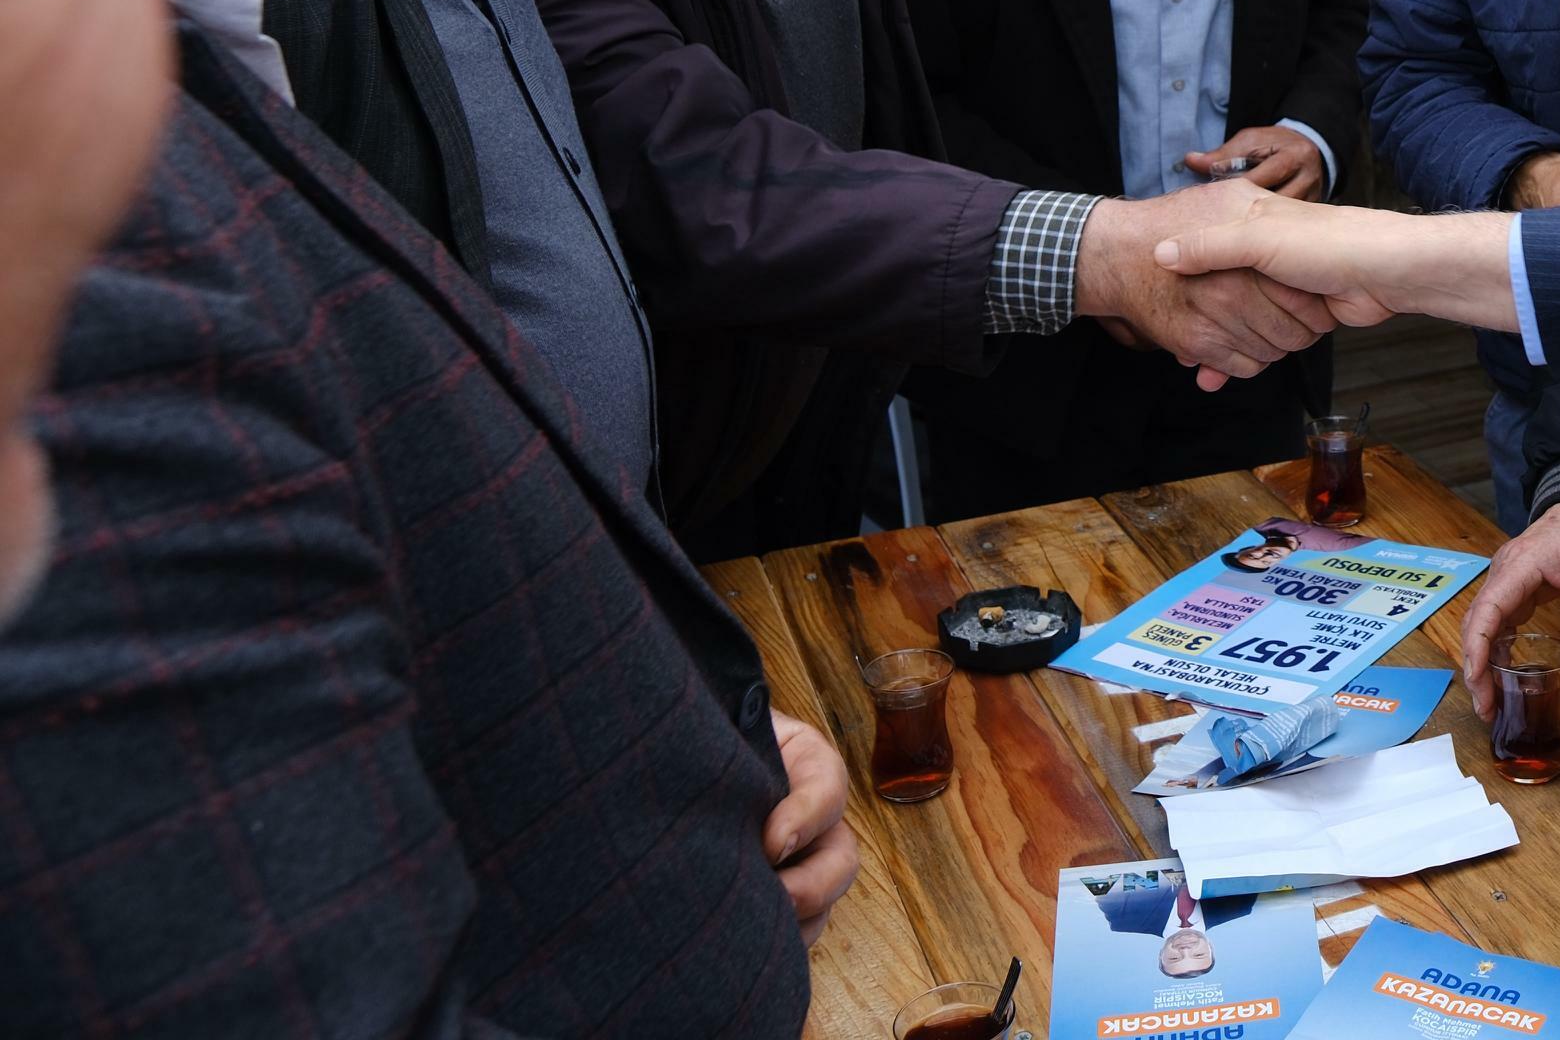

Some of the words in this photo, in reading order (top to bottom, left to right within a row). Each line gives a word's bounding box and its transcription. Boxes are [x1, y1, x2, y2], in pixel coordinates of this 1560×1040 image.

[1322, 557, 1396, 577] DEPOSU
[1261, 575, 1285, 586] KG
[1397, 571, 1427, 583] SU
[1424, 574, 1445, 588] 1
[1274, 580, 1349, 605] 300
[1204, 598, 1256, 614] MUSALLA
[1391, 595, 1421, 606] KENT
[1305, 610, 1347, 623] HATTI
[1386, 603, 1411, 617] 4
[1347, 616, 1388, 631] SUYU
[1185, 635, 1213, 651] 3
[1309, 634, 1362, 651] METRE
[1218, 637, 1342, 673] 1.957
[1164, 659, 1211, 673] OLSUN
[1214, 669, 1258, 683] HELAL
[1421, 967, 1521, 1005] ADANA
[1381, 976, 1541, 1031] KAZANACAK
[1103, 1001, 1273, 1035] KAZANACAK
